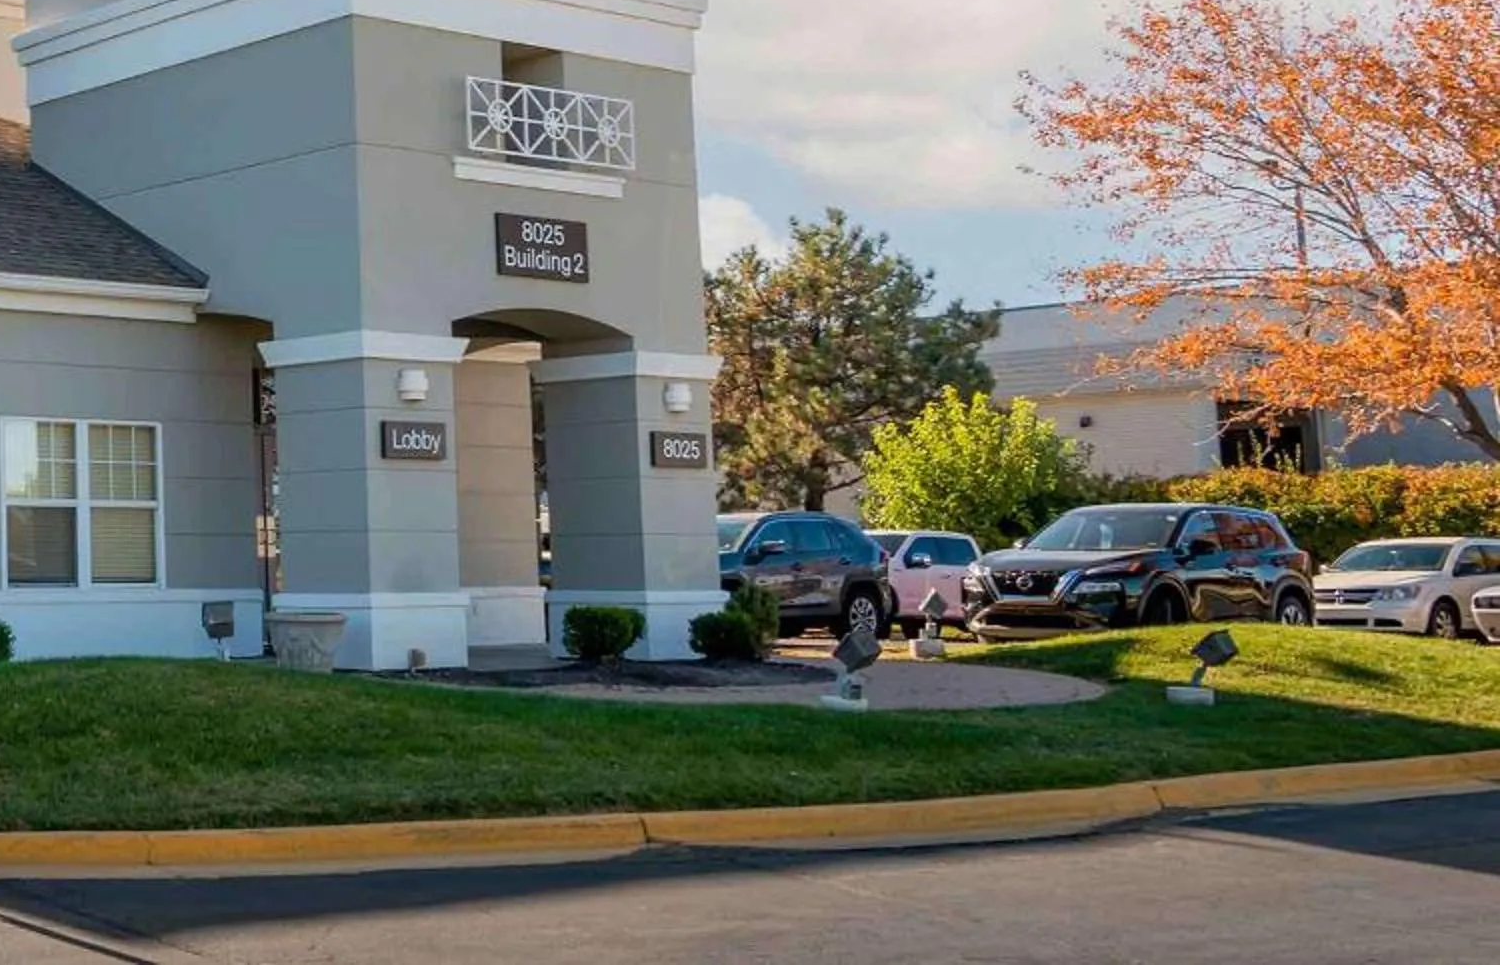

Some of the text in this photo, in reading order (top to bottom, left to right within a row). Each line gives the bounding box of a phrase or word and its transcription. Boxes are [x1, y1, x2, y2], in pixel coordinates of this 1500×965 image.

[521, 220, 565, 246] 8025
[392, 428, 441, 455] Lobby
[663, 438, 701, 460] 8025
